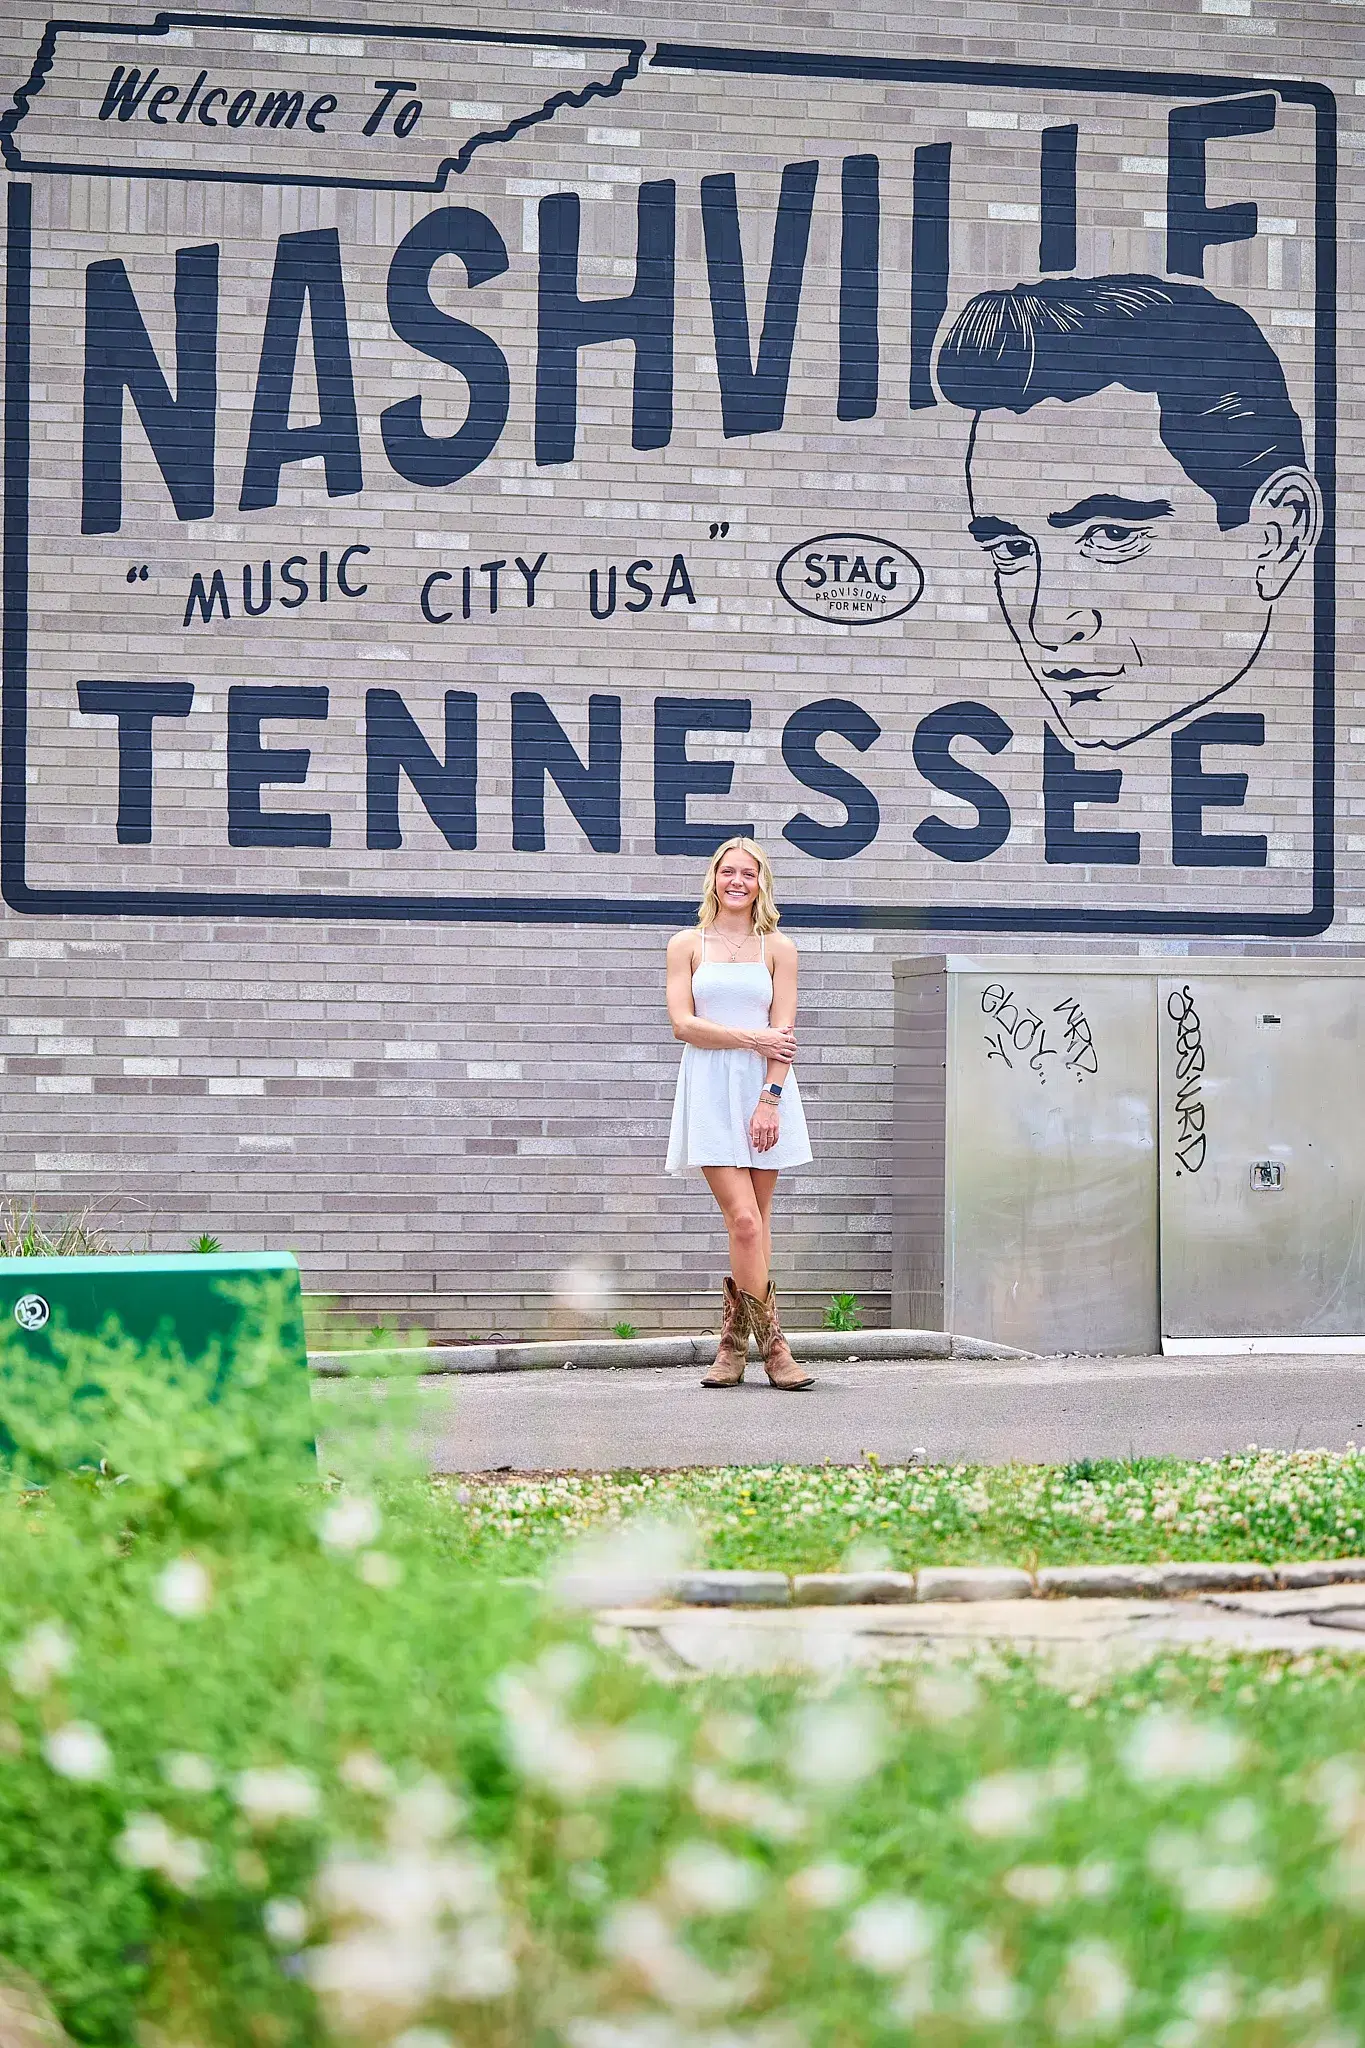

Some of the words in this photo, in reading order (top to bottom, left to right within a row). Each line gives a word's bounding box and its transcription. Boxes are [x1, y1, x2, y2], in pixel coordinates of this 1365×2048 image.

[98, 65, 338, 134] Welcome
[361, 80, 423, 138] To
[420, 552, 548, 624] CITY
[804, 553, 898, 591] STAG
[815, 586, 888, 605] PROVISIONS
[829, 601, 850, 612] FOR
[852, 602, 874, 613] MEN
[76, 679, 1268, 868] TENNESSEE
